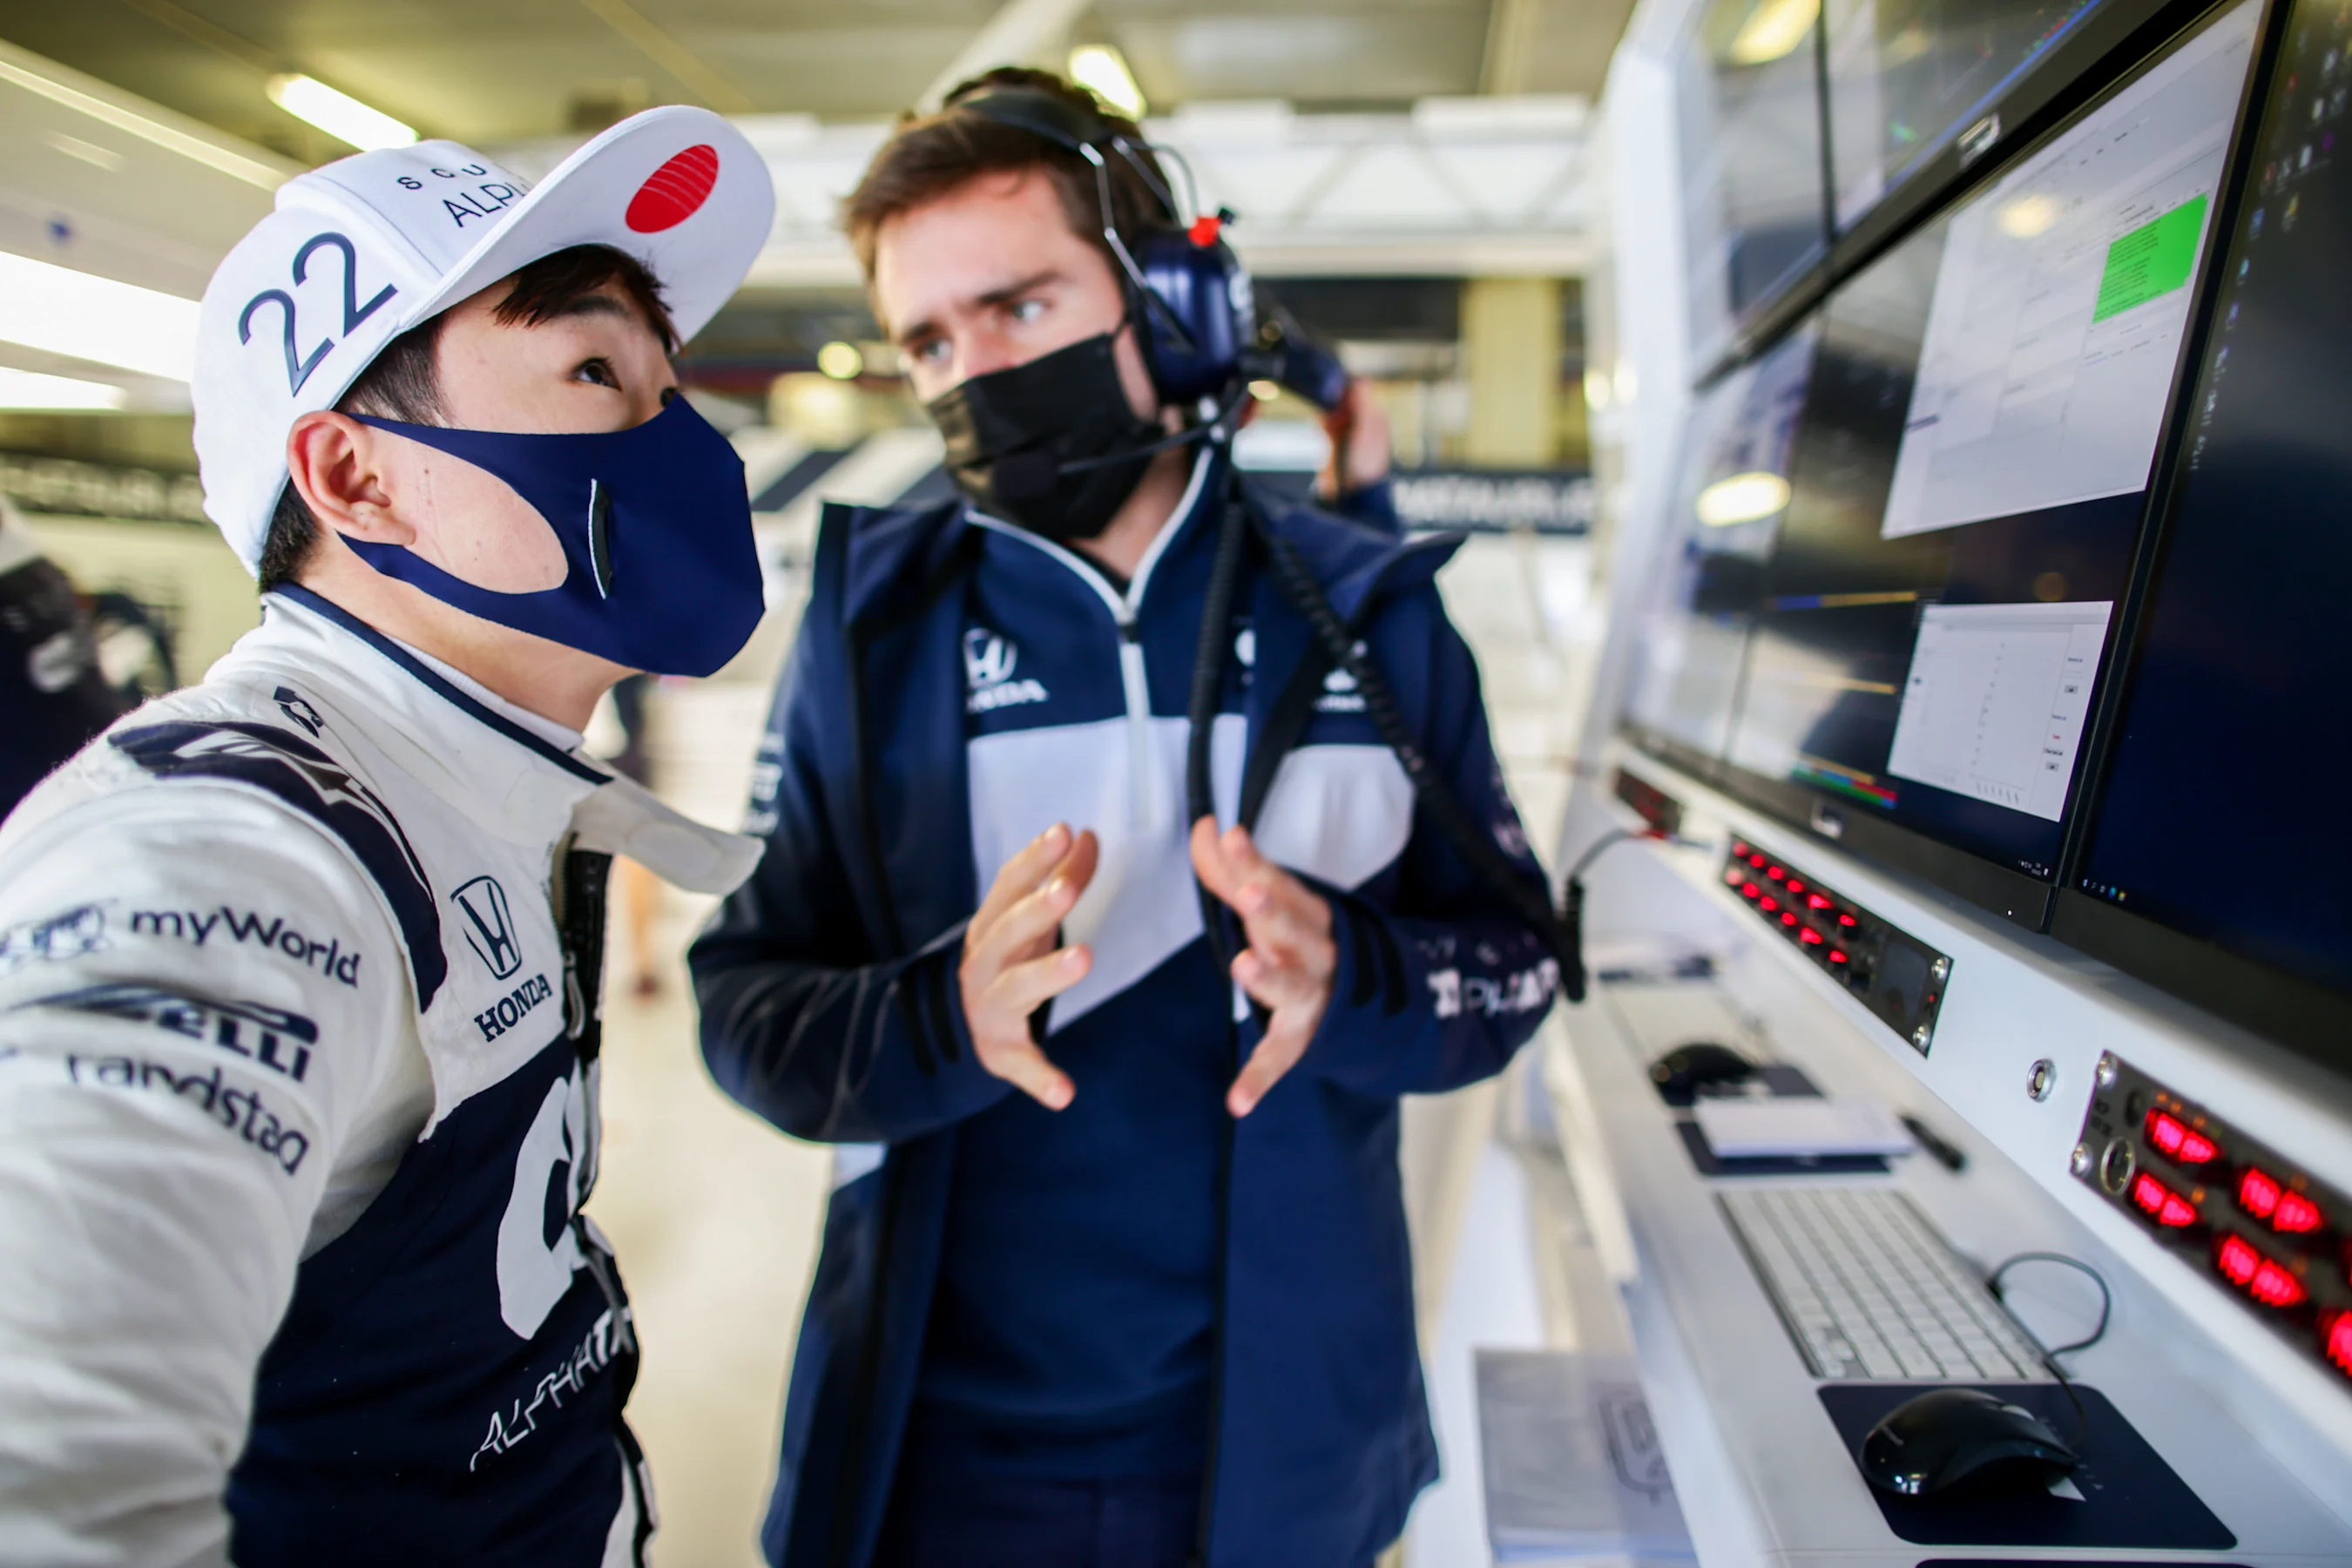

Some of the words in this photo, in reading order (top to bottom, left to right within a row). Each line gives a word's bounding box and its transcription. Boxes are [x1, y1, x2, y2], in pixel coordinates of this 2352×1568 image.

[237, 231, 400, 398] 22
[130, 905, 362, 989] myWorld
[473, 973, 553, 1043] HONDA
